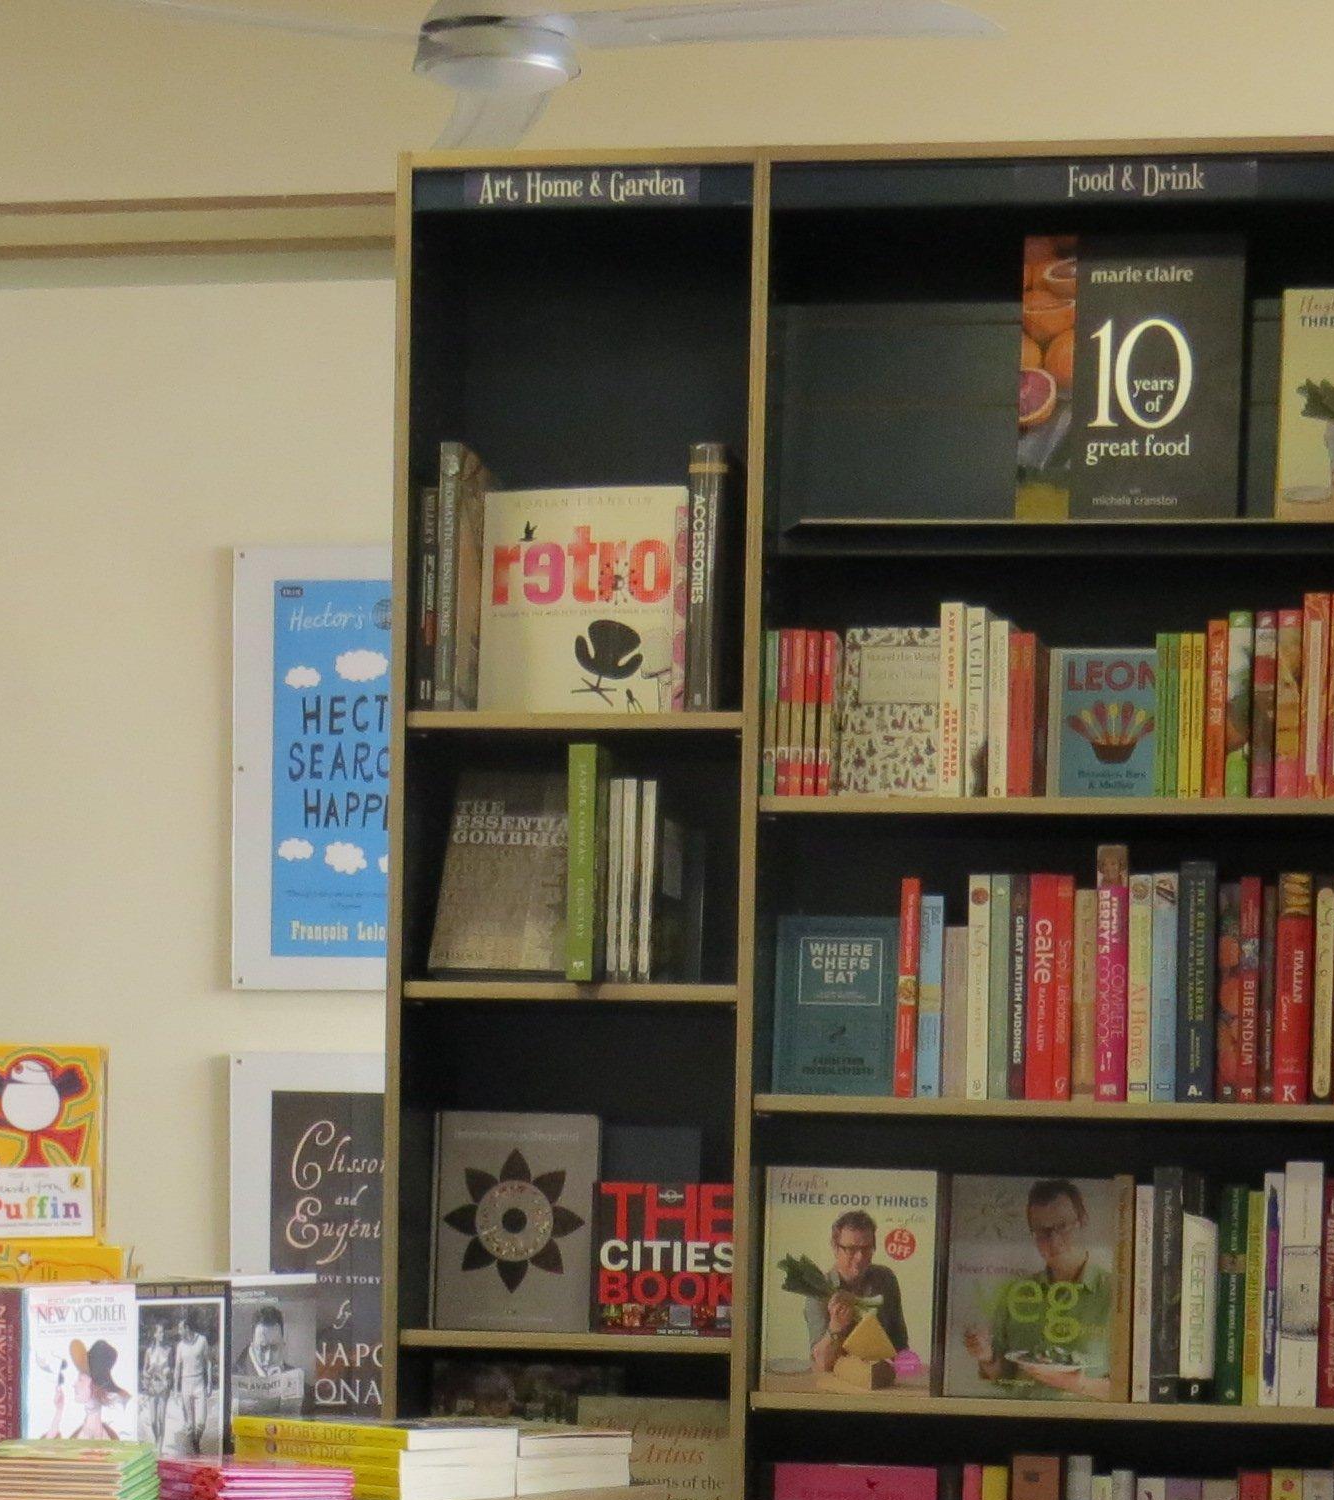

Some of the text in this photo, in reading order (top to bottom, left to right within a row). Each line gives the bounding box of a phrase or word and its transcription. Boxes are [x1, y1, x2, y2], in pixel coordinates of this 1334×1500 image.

[526, 171, 583, 204] Home
[589, 173, 604, 198] &
[610, 170, 686, 202] Garden
[1067, 163, 1204, 198] Food & Drink
[1090, 264, 1194, 284] marie claire
[1085, 318, 1194, 430] 10
[1132, 373, 1176, 395] years
[1144, 395, 1162, 414] of
[1084, 432, 1191, 466] great food
[689, 493, 709, 604] ACCESSORIES
[289, 602, 365, 635] Hector's
[1066, 659, 1157, 692] LEON
[457, 800, 506, 815] THE
[1097, 889, 1111, 954] BERRY'S
[808, 941, 874, 958] WHERE
[811, 956, 871, 971] CHEFS
[1033, 918, 1058, 984] cake
[823, 970, 857, 984] EAT
[1011, 916, 1025, 1065] GREAT BRITISH PUDDINGS
[1240, 980, 1256, 1066] BIBENDUM
[334, 1186, 358, 1206] and
[599, 1182, 734, 1243] THE
[779, 1191, 929, 1208] THREE GOOD THINGS
[888, 1243, 914, 1260] OFF
[891, 1229, 913, 1244] £5
[598, 1239, 735, 1273] CITIES
[597, 1270, 733, 1304] BOOK
[36, 1303, 127, 1323] NEW YORKER
